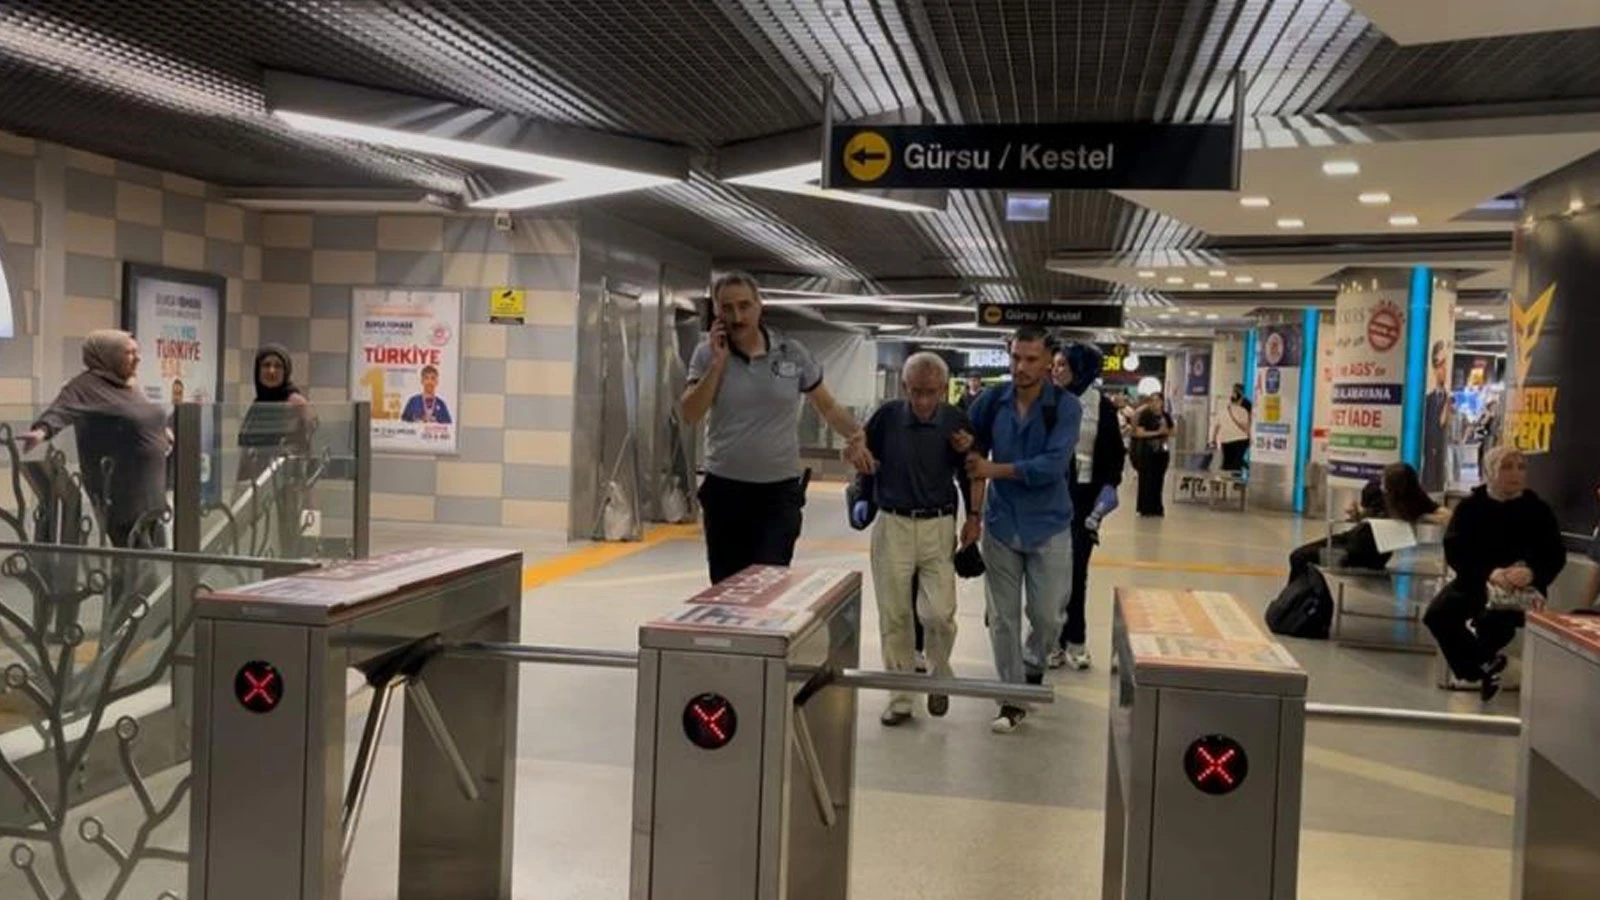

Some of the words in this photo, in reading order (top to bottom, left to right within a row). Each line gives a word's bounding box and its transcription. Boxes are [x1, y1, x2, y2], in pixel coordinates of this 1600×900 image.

[903, 143, 990, 170] Gürsu
[998, 143, 1012, 170] /
[1020, 143, 1115, 170] Kestel
[1005, 308, 1038, 321] Gürsu
[1047, 310, 1082, 322] Kestel
[364, 344, 441, 366] TÜRKİYE
[1347, 407, 1382, 428] İADE
